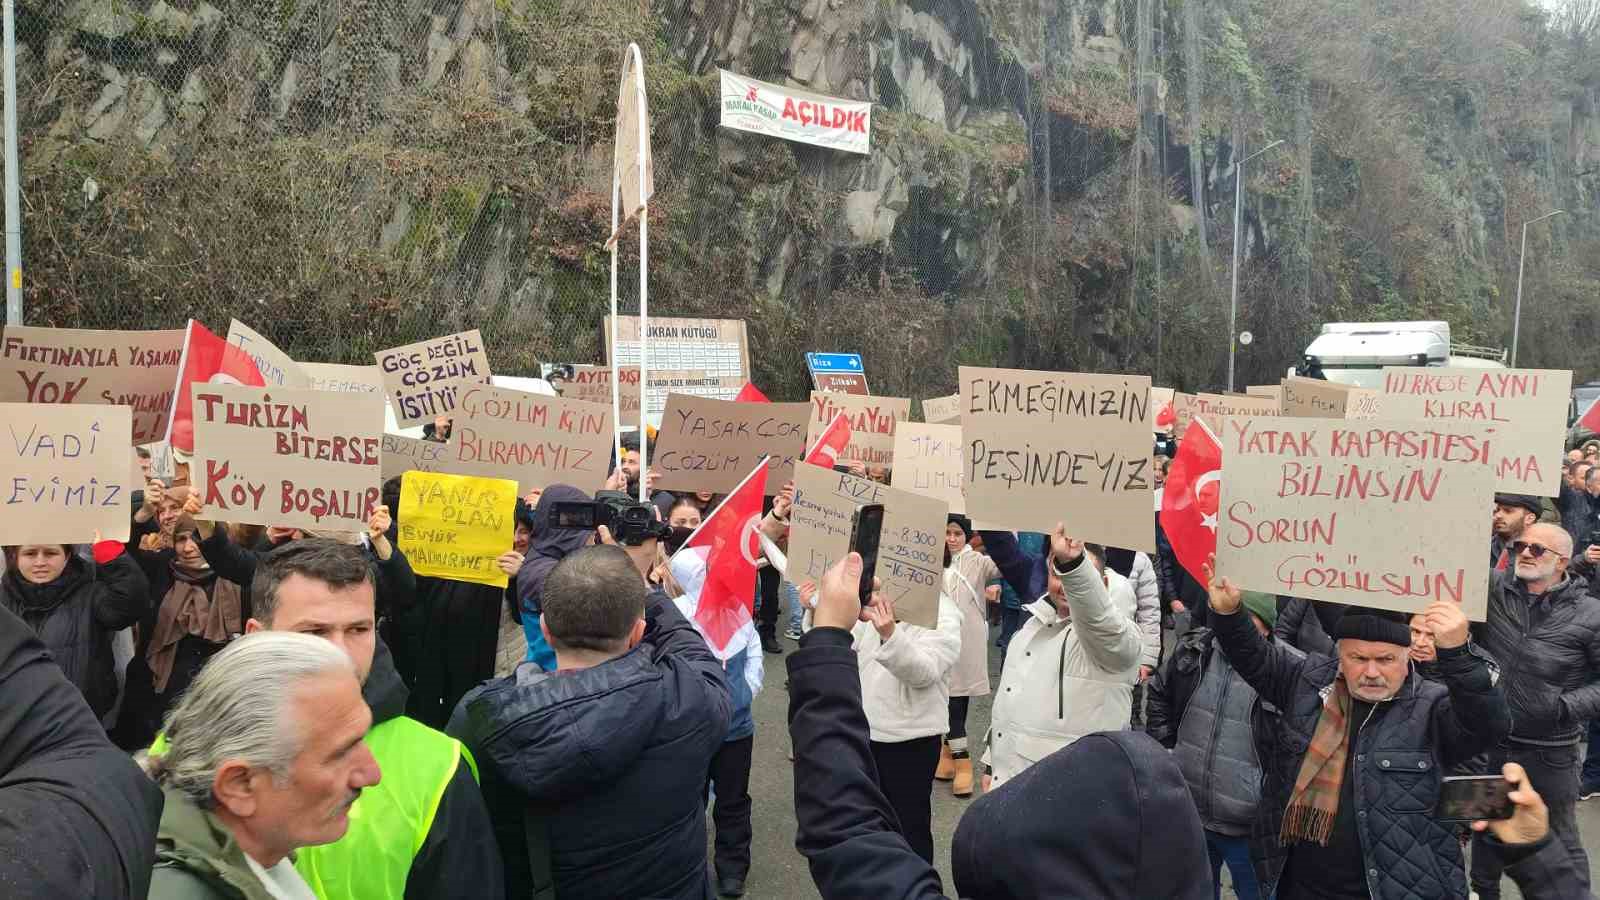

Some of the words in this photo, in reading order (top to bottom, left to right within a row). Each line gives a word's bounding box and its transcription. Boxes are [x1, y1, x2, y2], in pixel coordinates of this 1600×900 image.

[782, 97, 867, 133] AÇILDIK
[639, 324, 679, 339] ÜKRAN
[382, 352, 421, 373] GÖÇ
[427, 335, 479, 360] DEĞİL
[17, 370, 89, 404] YOK
[402, 358, 479, 388] ÇÖZÜM
[576, 370, 614, 384] AYIT
[1475, 373, 1539, 398] AYNI
[197, 393, 310, 432] TURİZM
[969, 378, 1149, 423] EKMEĞİMİZİN
[1423, 399, 1511, 422] KURAL
[677, 408, 750, 439] YASAK
[275, 431, 379, 465] BİTERSE
[456, 427, 593, 472] BURADAYIZ
[1231, 419, 1319, 458] YATAK
[1330, 427, 1496, 465] KAPASİTESİ
[659, 450, 740, 472] ÇÖZÜM
[204, 459, 266, 511] KÖY
[280, 479, 380, 523] BOŞALIR
[1277, 461, 1443, 504] BİLİNSİN
[441, 505, 504, 531] PLAN
[1227, 500, 1338, 549] SORUN
[1276, 552, 1465, 603] ÇÖZÜLSÜN
